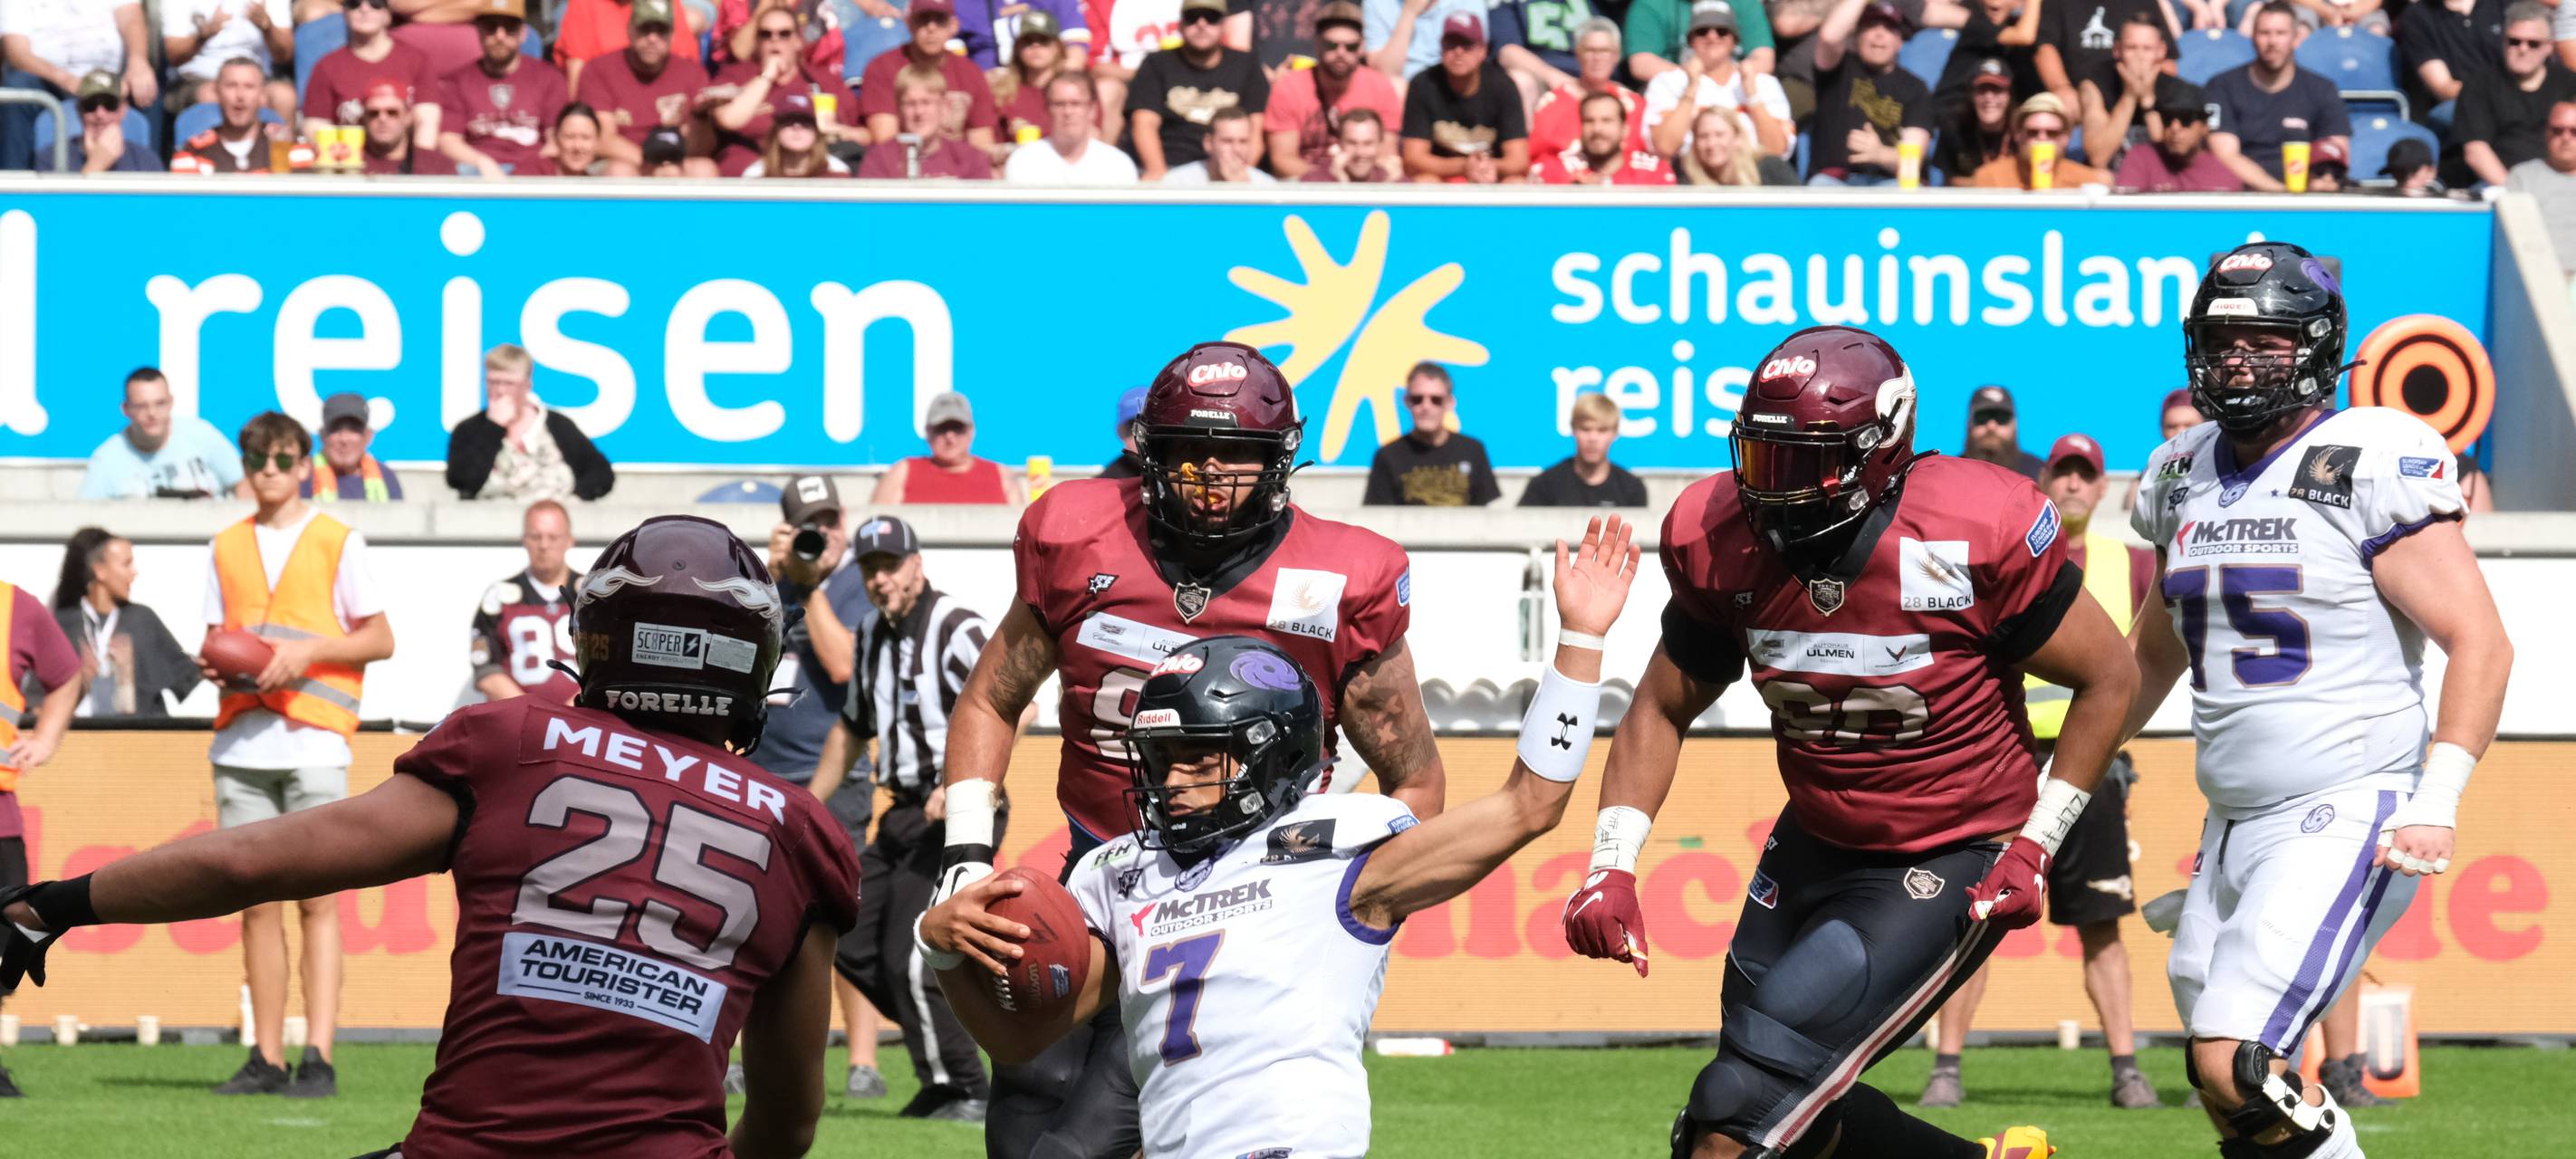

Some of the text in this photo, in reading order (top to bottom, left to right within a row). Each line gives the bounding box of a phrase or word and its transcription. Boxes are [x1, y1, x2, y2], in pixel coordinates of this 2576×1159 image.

[2219, 253, 2273, 273] Chio
[1552, 226, 2267, 328] schauinslan
[146, 211, 956, 441] reisen
[1188, 361, 1247, 386] Chio
[1762, 355, 1817, 381] Chio
[1552, 340, 1750, 438] reis
[1190, 409, 1231, 419] FORELLE
[1752, 414, 1788, 424] FORELLE
[2158, 456, 2193, 478] FFH
[2290, 487, 2350, 507] 28 BLACK
[2192, 517, 2298, 544] McTREK
[2189, 543, 2299, 557] OUTDOOR SPORTS
[1903, 593, 1973, 609] 28 BLACK
[1269, 618, 1334, 639] 28 BLACK
[2160, 563, 2312, 693] 75
[1806, 648, 1855, 659] ULMEN
[605, 689, 734, 716] FORELLE
[1137, 713, 1172, 725] Riddell
[543, 717, 787, 826] MEYER
[1094, 843, 1131, 866] FFH
[511, 773, 773, 972] 25
[1154, 877, 1274, 924] McTREK
[1151, 899, 1273, 937] OUTDOOR SPORTS
[524, 939, 709, 996] AMERICAN
[519, 959, 703, 1016] TOURISTER
[584, 991, 635, 1009] SINCE 1933
[1141, 928, 1226, 1068] 7
